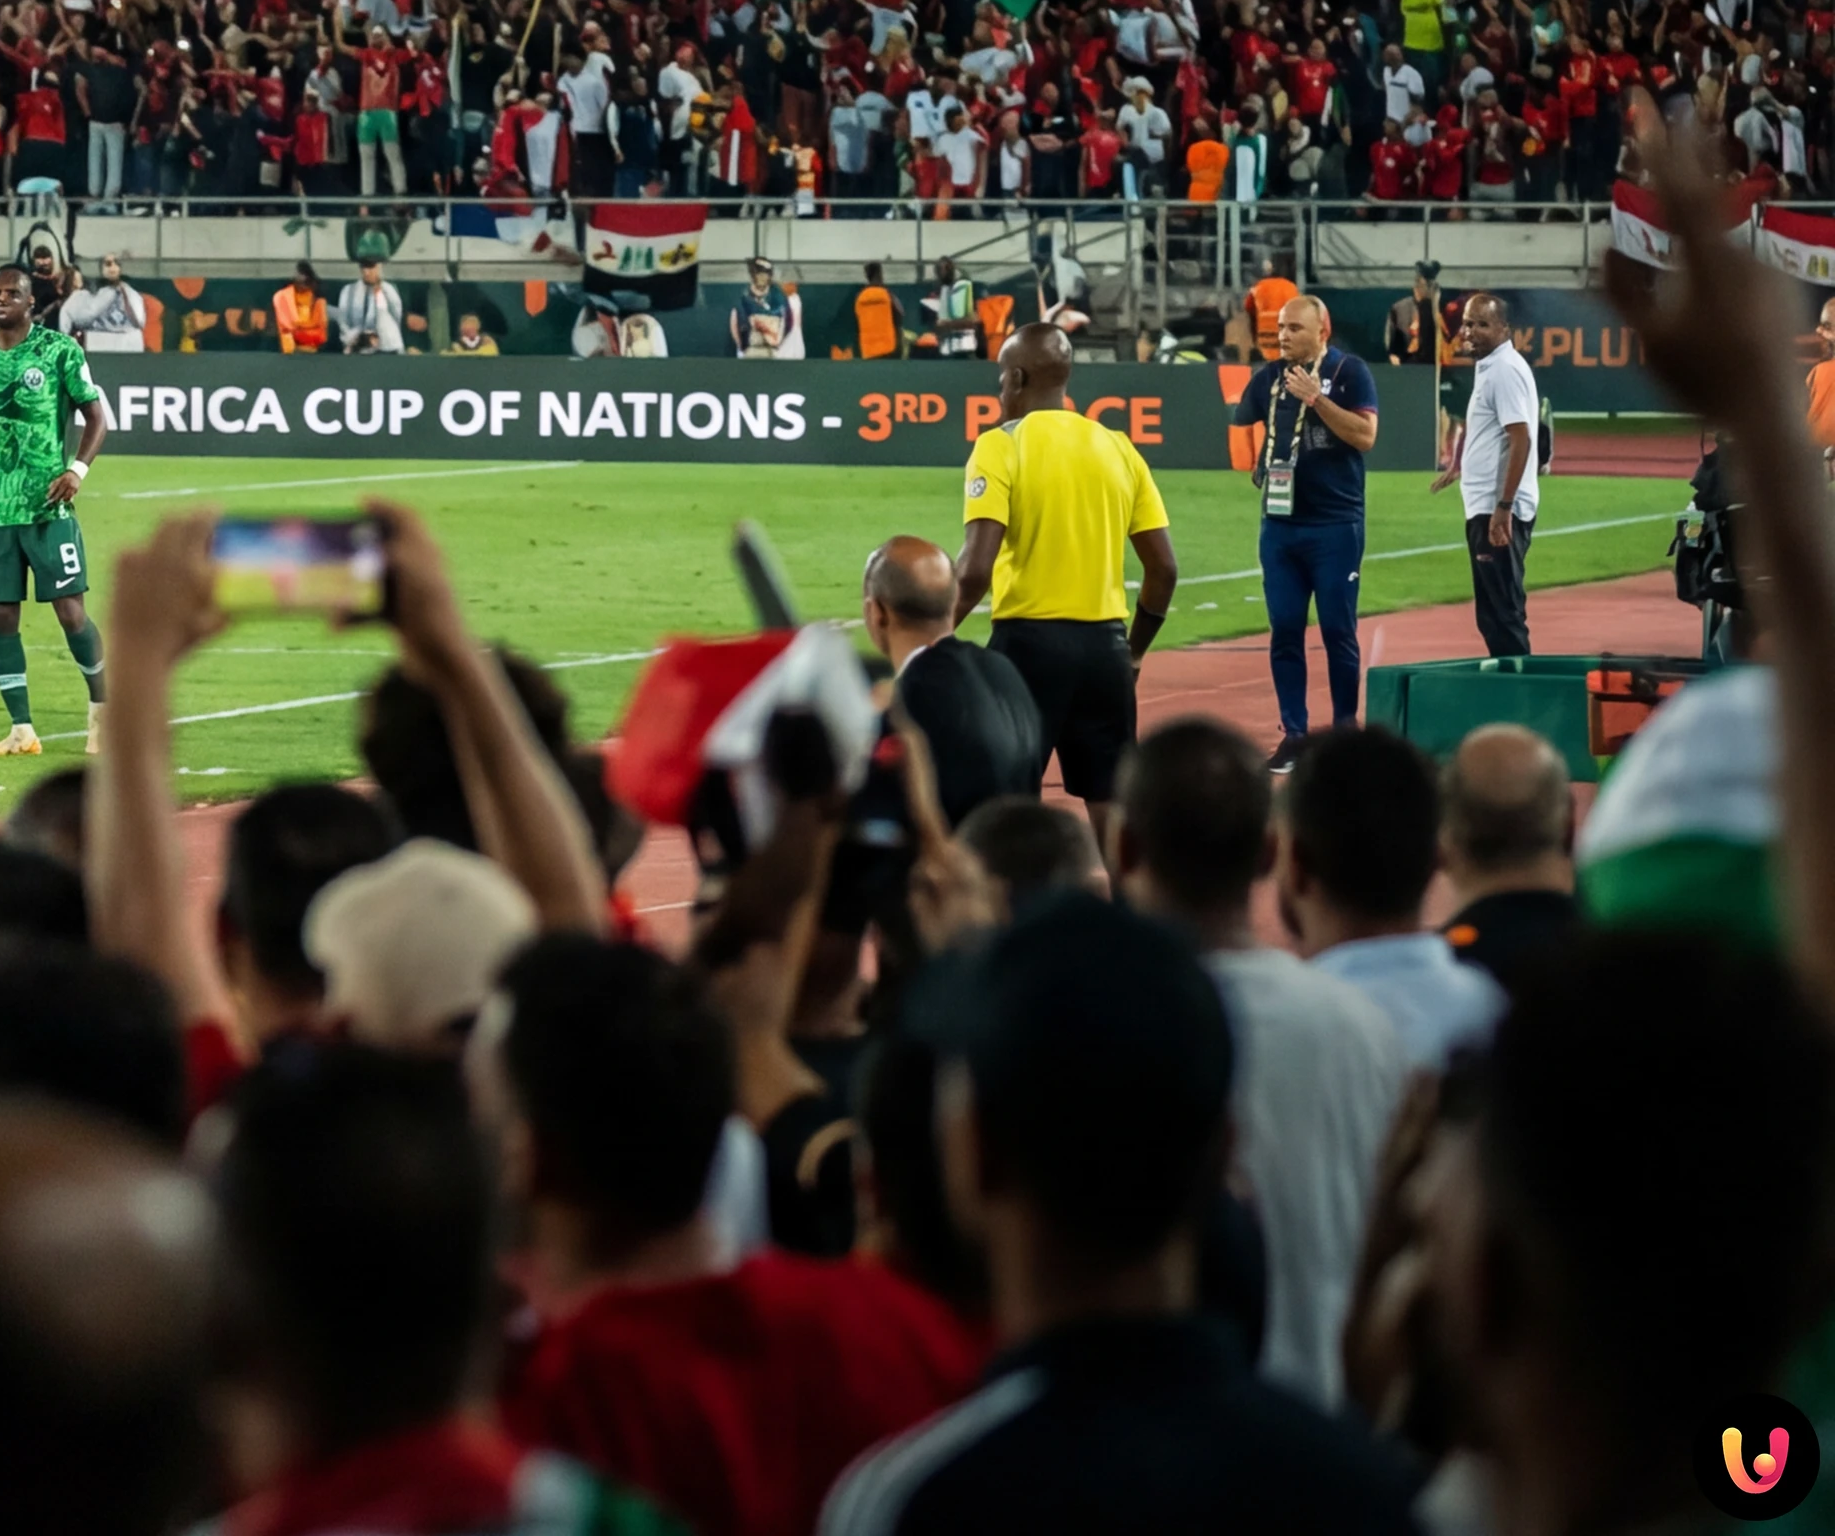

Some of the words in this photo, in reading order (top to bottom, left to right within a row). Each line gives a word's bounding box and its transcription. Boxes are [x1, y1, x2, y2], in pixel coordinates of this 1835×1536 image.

[303, 387, 424, 436] CUP
[439, 389, 521, 437] OF
[539, 391, 806, 441] NATIONS
[822, 416, 842, 428] -
[858, 393, 947, 441] 3RD
[966, 396, 1163, 444] PCE
[59, 542, 82, 575] 9
